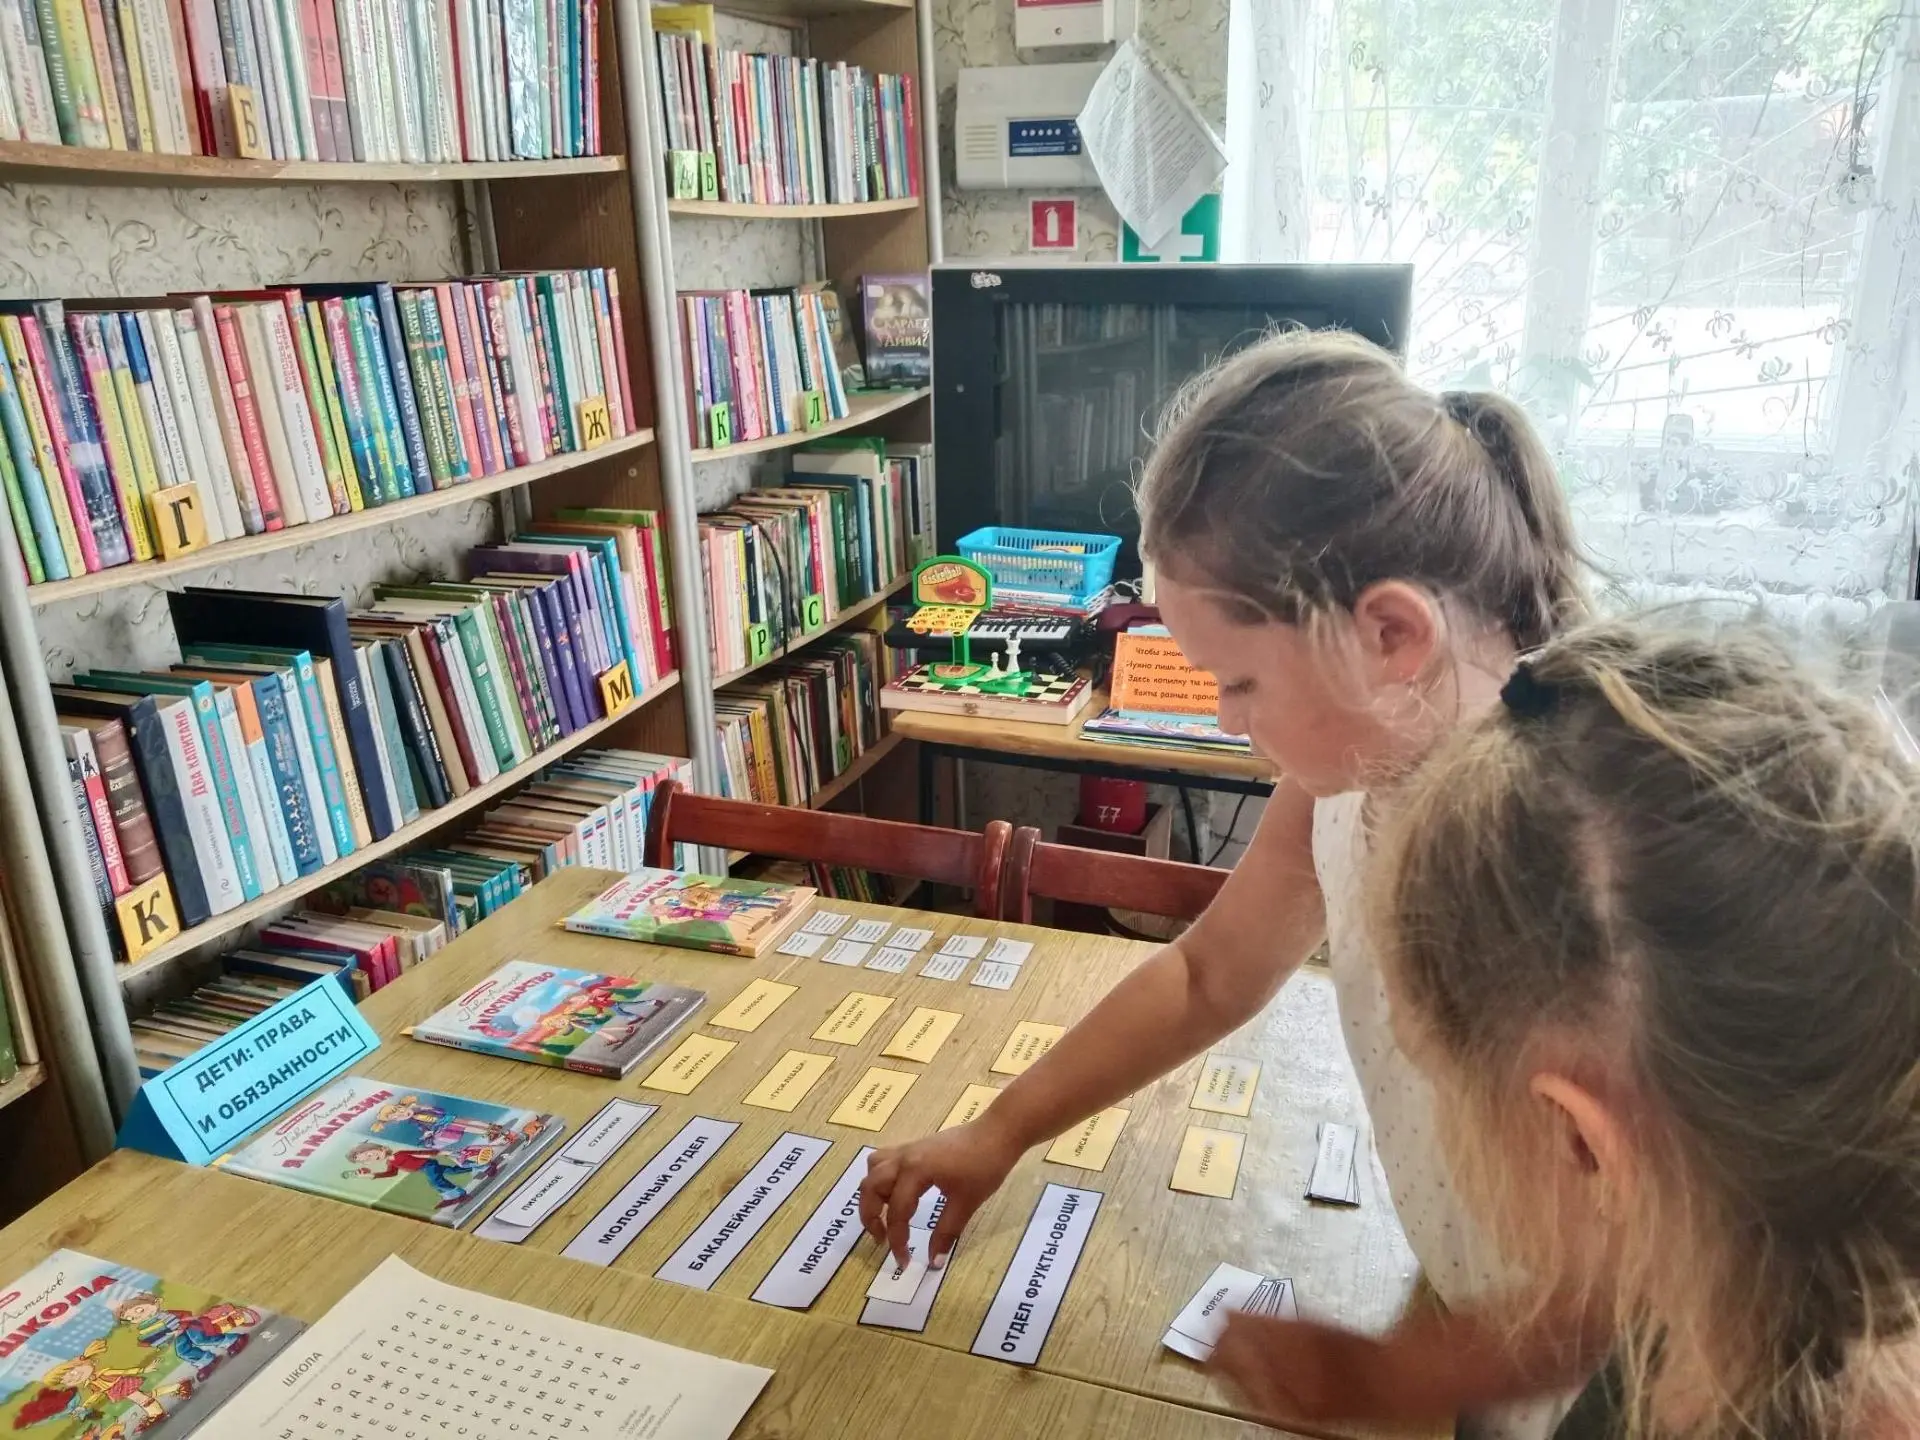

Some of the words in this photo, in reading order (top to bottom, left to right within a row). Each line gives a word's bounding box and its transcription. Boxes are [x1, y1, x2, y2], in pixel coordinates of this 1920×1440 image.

[240, 99, 259, 147] Б
[706, 163, 714, 192] Б
[585, 407, 606, 441] Ж
[717, 412, 728, 440] К
[809, 397, 821, 424] Л
[168, 495, 194, 549] Г
[808, 600, 819, 626] С
[757, 629, 767, 657] Р
[1136, 647, 1160, 658] Чтобы
[607, 670, 631, 710] М
[1127, 674, 1151, 684] Здесь
[1153, 676, 1187, 688] копилку
[1190, 678, 1201, 687] ты
[1160, 690, 1189, 700] разные
[174, 710, 202, 767] КАПИТАНА
[94, 798, 122, 869] Искандер
[1097, 805, 1122, 824] 77
[131, 889, 169, 946] К
[482, 970, 555, 1023] ГОСУДАРСТВО
[194, 1047, 255, 1093] ДЕТИ:
[253, 1007, 317, 1052] ПРАВА
[197, 1118, 217, 1135] И
[218, 1025, 353, 1120] ОБЯЗАННОСТИ
[282, 1157, 301, 1169] Я
[304, 1089, 395, 1150] МАГАЗИН
[587, 1115, 623, 1148] СУХАРИКИ
[520, 1174, 565, 1212] ПИРОЖНОЕ
[597, 1171, 673, 1246] МОЛОЧНЫЙ
[669, 1134, 710, 1174] ОТДЕЛ
[687, 1185, 770, 1273] БАКАЛЕЙНЫЙ
[766, 1146, 807, 1184] ОТДЕЛ
[798, 1218, 848, 1275] МЯСНОЙ
[1000, 1300, 1035, 1353] ОТДЕЛ
[1024, 1193, 1081, 1299] ФРУКТЫ-ОВОЩИ
[1201, 1287, 1229, 1317] ФОРЕЛЬ
[282, 1351, 324, 1388] ШКОЛА
